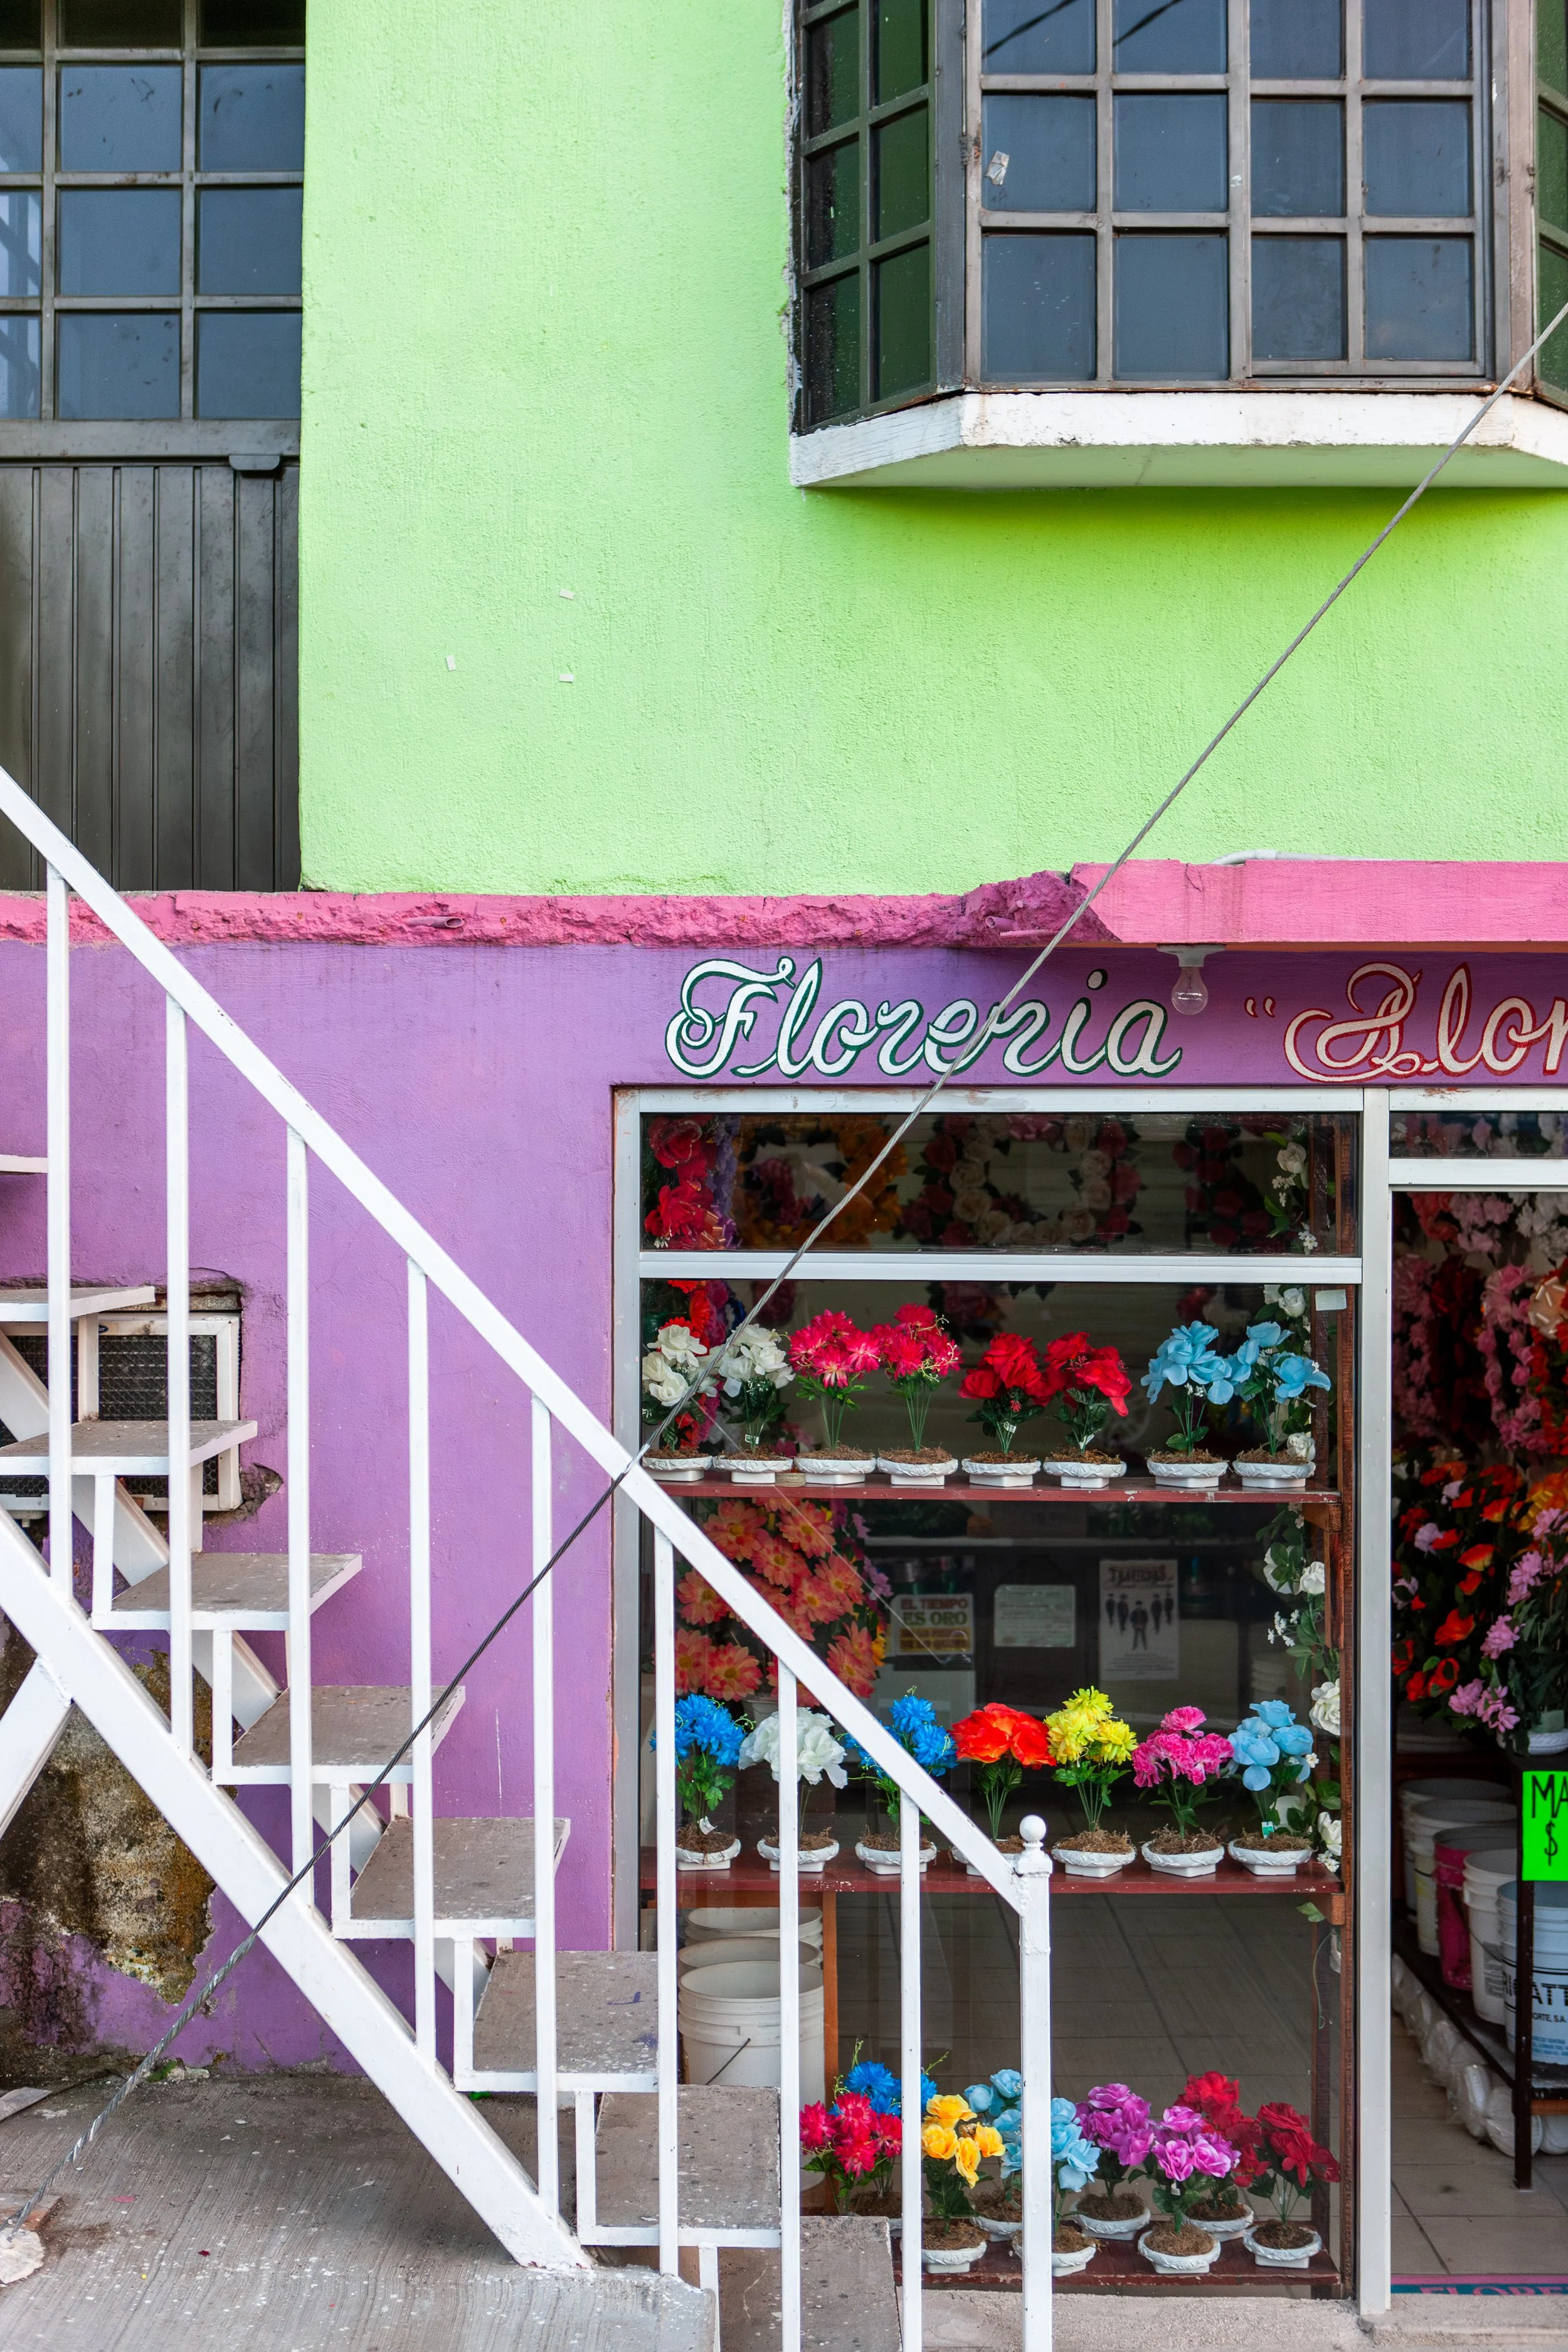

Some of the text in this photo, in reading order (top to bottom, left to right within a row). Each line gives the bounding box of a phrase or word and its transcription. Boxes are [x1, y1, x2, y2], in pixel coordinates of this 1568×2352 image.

[664, 956, 1183, 1078] Floreria
[901, 1598, 968, 1610] EL TIEMPO
[903, 1611, 968, 1626] ES ORO
[1544, 1820, 1558, 1867] $
